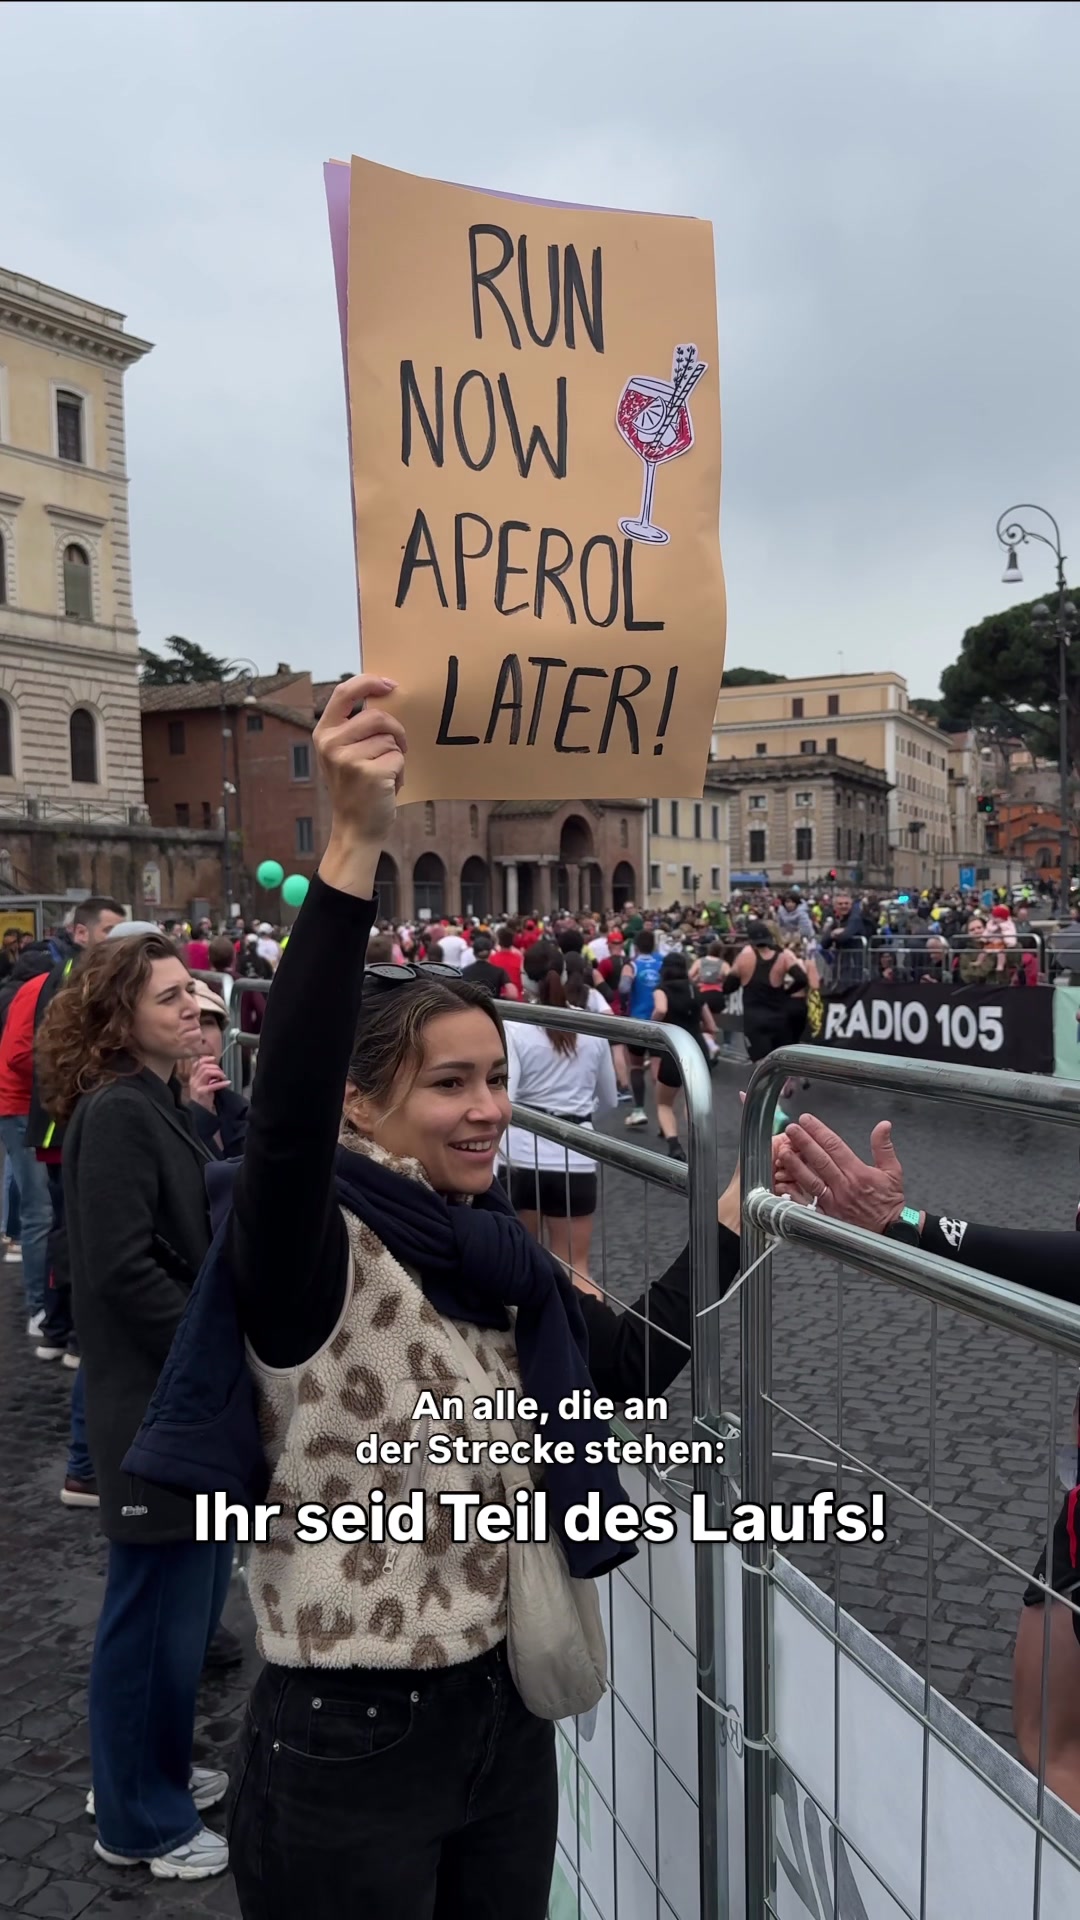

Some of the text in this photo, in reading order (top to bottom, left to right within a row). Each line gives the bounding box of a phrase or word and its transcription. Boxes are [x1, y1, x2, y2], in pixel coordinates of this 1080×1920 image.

[469, 222, 604, 354] RUN
[400, 359, 567, 479] NOW
[395, 508, 665, 631] APEROL
[436, 653, 679, 756] LATER!
[825, 1000, 1004, 1052] RADIO 105
